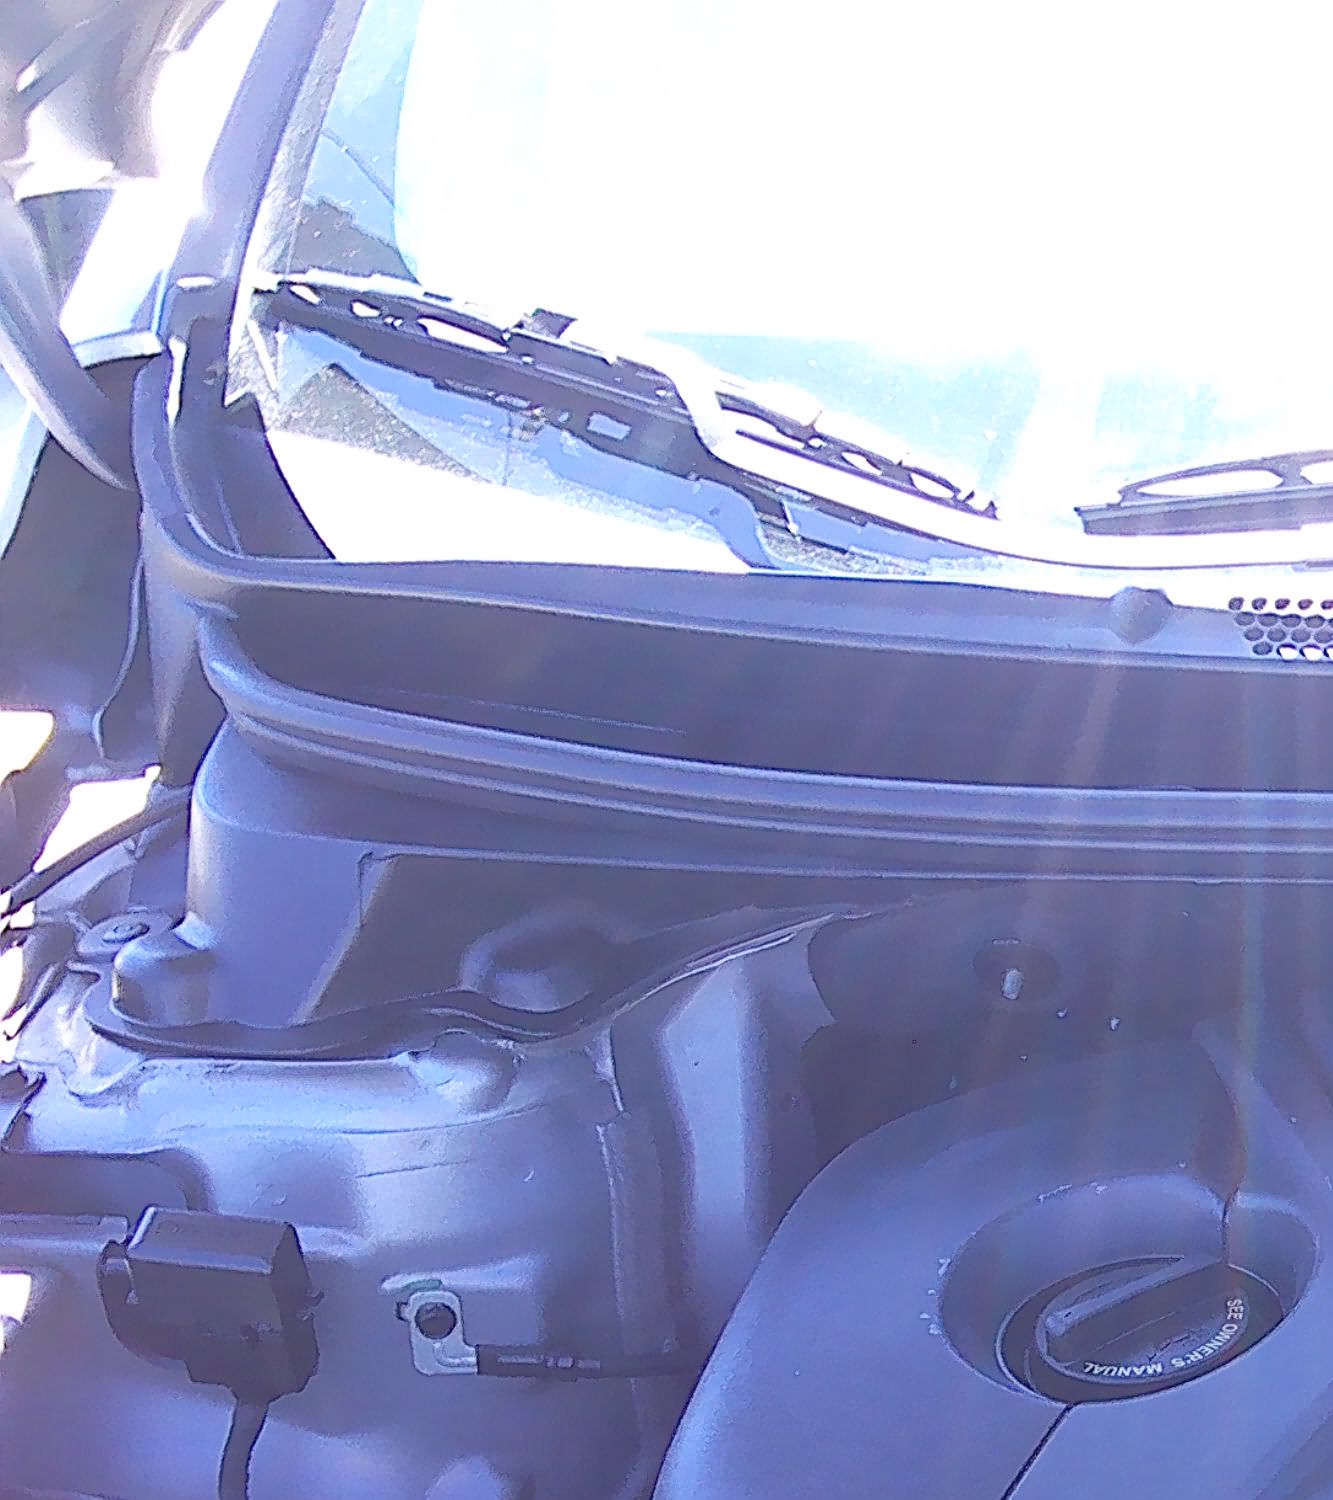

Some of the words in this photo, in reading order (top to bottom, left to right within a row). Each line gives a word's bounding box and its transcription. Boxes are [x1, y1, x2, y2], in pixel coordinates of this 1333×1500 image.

[1227, 1297, 1244, 1320] SEE
[1170, 1323, 1239, 1368] OWNER'S
[1083, 1360, 1163, 1378] MANUAL
